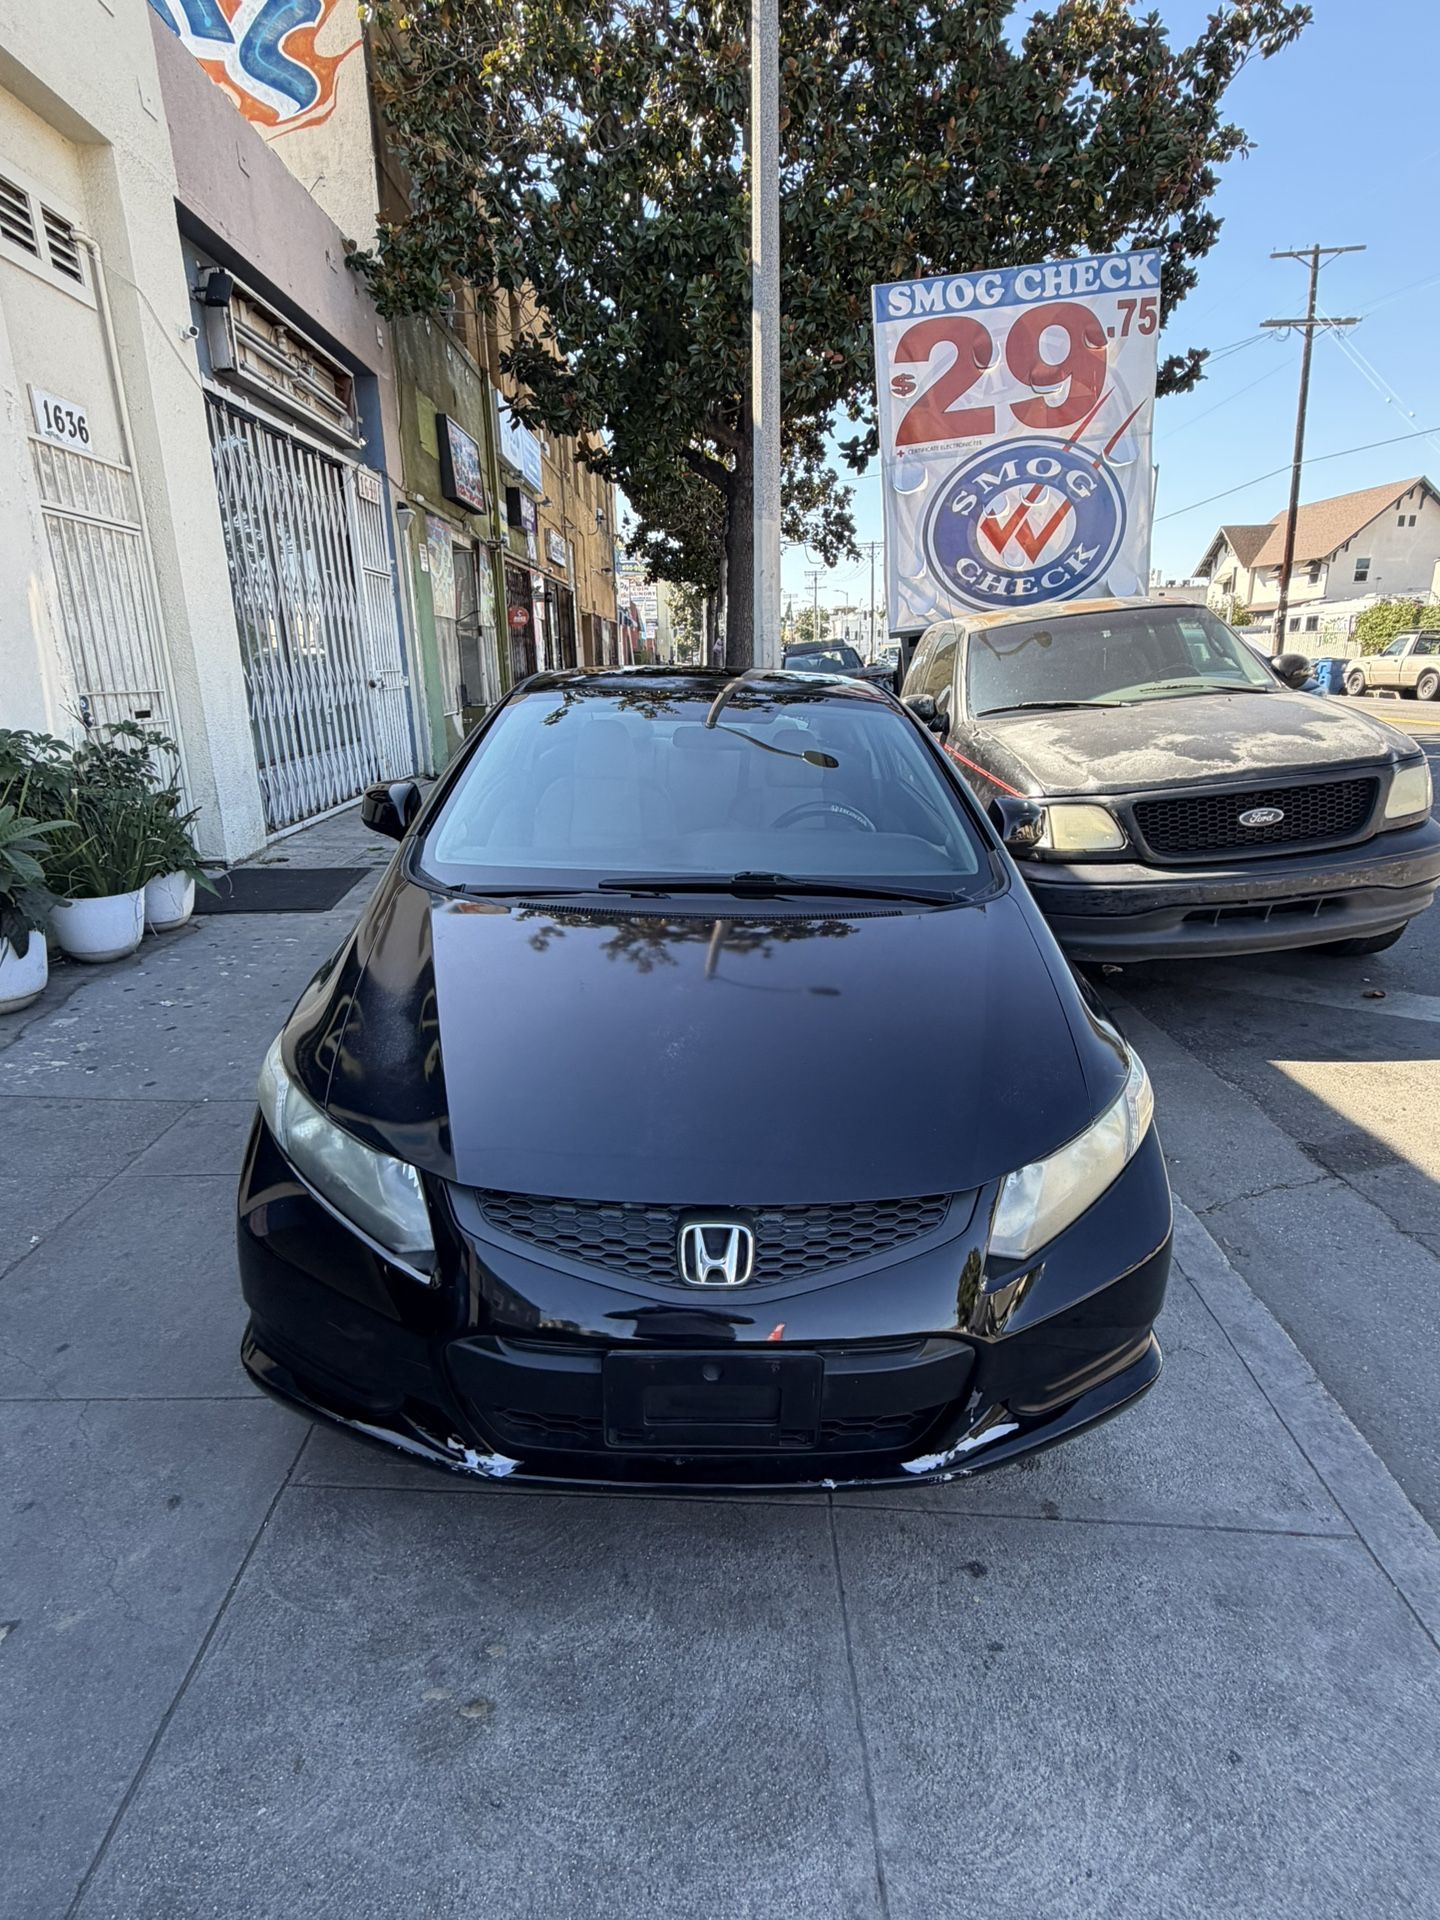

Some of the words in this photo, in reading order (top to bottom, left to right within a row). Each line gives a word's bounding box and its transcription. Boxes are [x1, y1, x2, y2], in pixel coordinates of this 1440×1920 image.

[888, 274, 1004, 317] SMOG
[1014, 254, 1158, 300] CHECK
[43, 399, 89, 444] 1636
[908, 445, 939, 454] CERTIFICATE
[940, 441, 974, 450] ELECTRONIC
[952, 457, 1098, 516] SMOG
[956, 543, 1101, 596] CHECK
[1249, 811, 1275, 824] Ford
